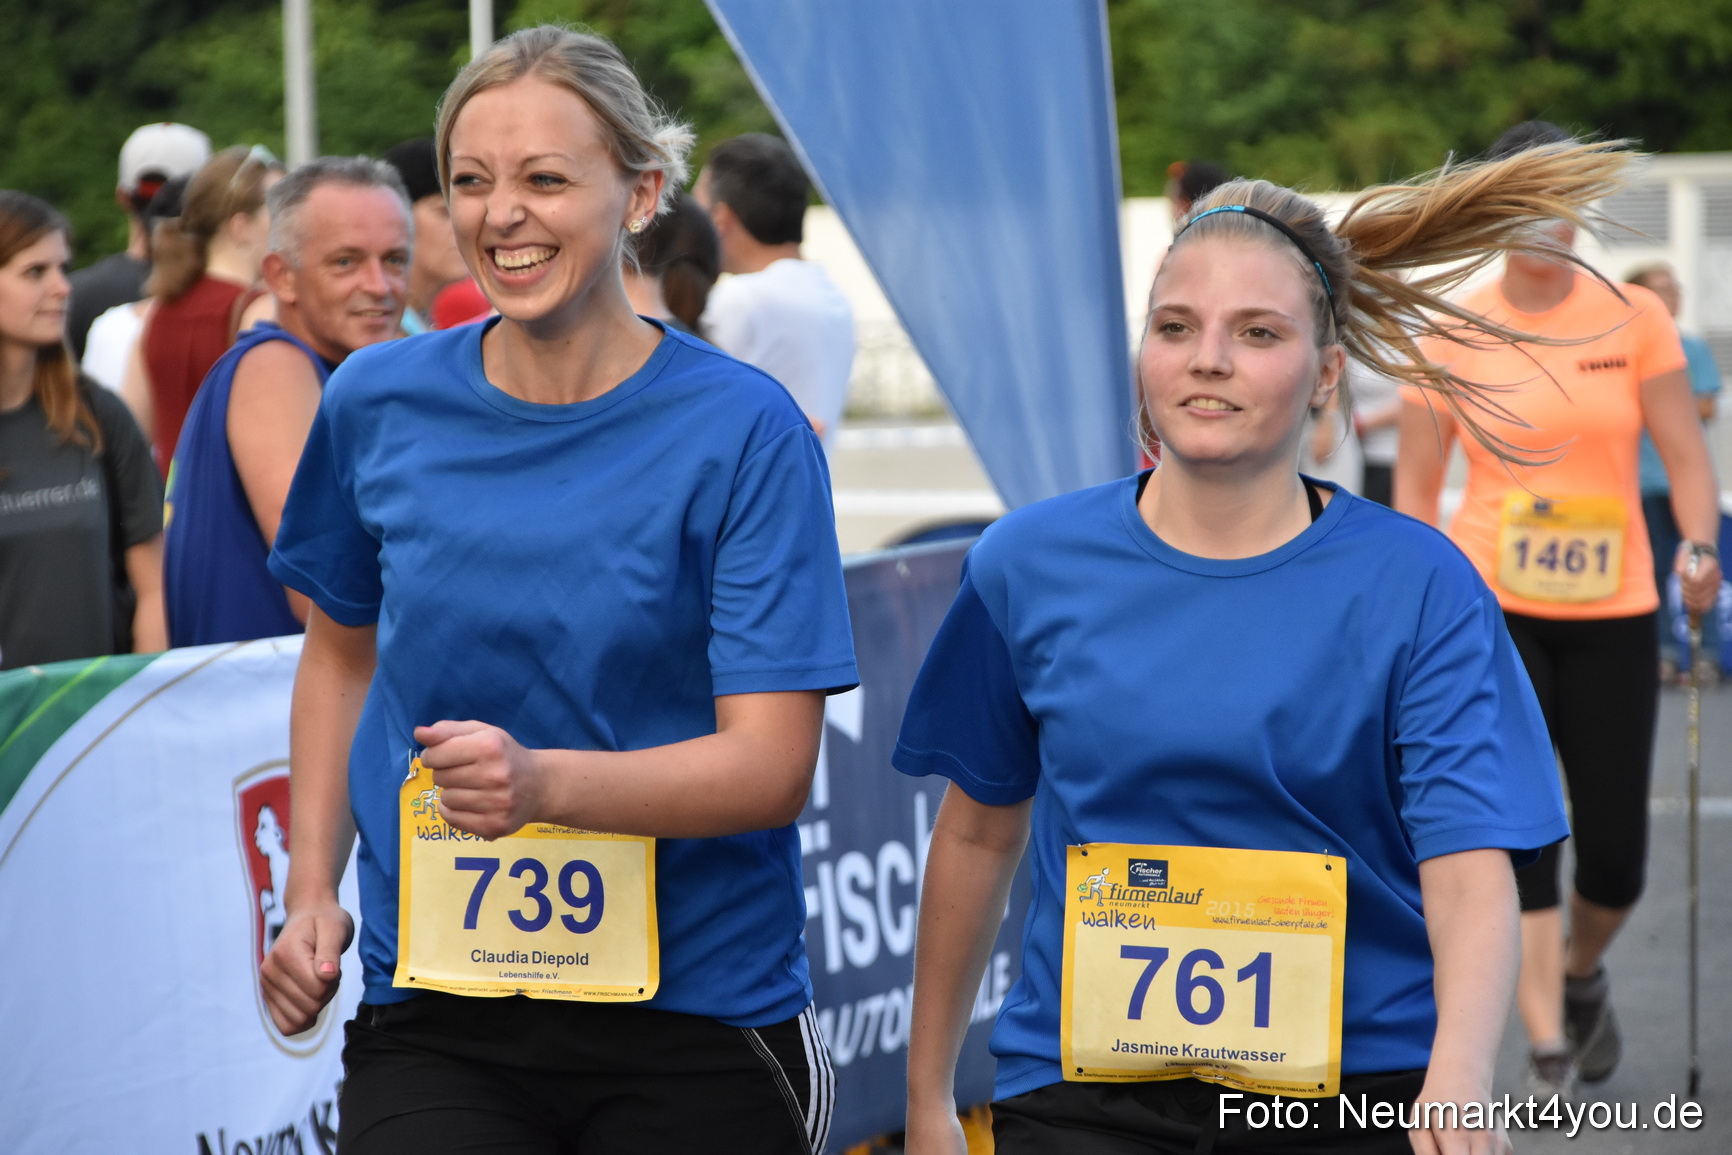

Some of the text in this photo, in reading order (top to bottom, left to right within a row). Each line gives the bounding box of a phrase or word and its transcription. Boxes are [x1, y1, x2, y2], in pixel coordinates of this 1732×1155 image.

[1513, 536, 1611, 577] 1461
[416, 823, 487, 842] walke
[454, 857, 605, 934] 739
[1109, 883, 1204, 905] firmenlauf
[1205, 900, 1256, 917] 2015
[1082, 909, 1156, 930] walken
[471, 949, 589, 968] Claudia Diepold
[499, 971, 560, 980] Lebenshilfe e.V.
[1120, 945, 1272, 1028] 761
[1111, 1038, 1286, 1063] Jasmine Krautwasser
